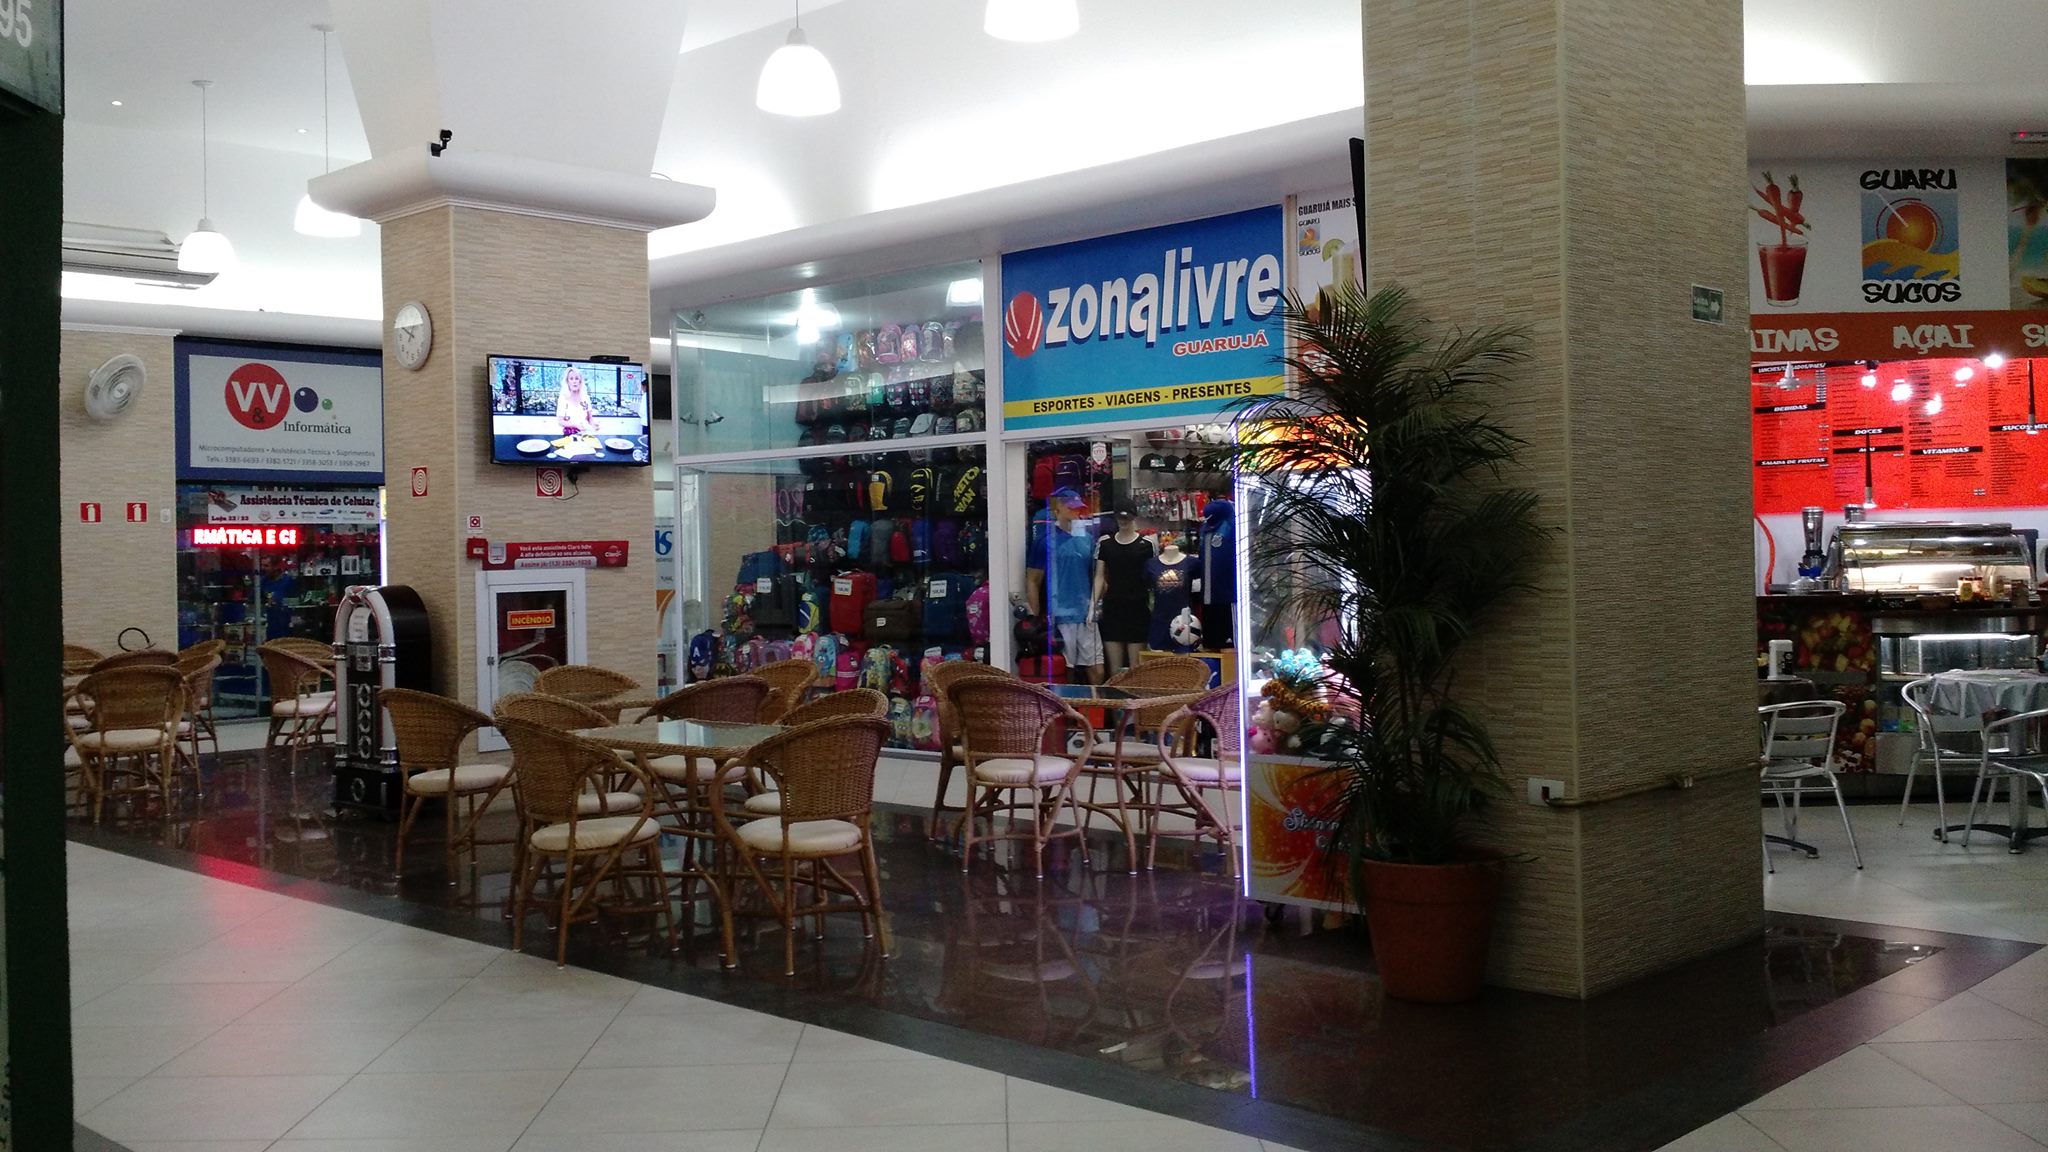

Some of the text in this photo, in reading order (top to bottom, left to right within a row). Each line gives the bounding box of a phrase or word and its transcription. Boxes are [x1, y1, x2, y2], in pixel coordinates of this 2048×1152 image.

[1859, 169, 1958, 191] GUARU
[1298, 200, 1331, 216] GUARUJÁ
[1332, 198, 1351, 211] MAIS
[1046, 246, 1281, 346] zonalivre
[1861, 282, 1962, 304] SUCOS
[1173, 329, 1269, 357] GUARUJÁ
[1893, 325, 1975, 354] AÇAI
[1033, 398, 1095, 413] ESPORTES
[1105, 391, 1161, 407] VIAGENS
[1173, 382, 1251, 400] PRESENTES
[284, 421, 351, 434] Informática
[1922, 447, 1970, 455] VITAMINAS
[240, 494, 375, 507] Assistência Técnica de Celular
[266, 529, 276, 545] E
[511, 615, 551, 625] INCÊNDIO
